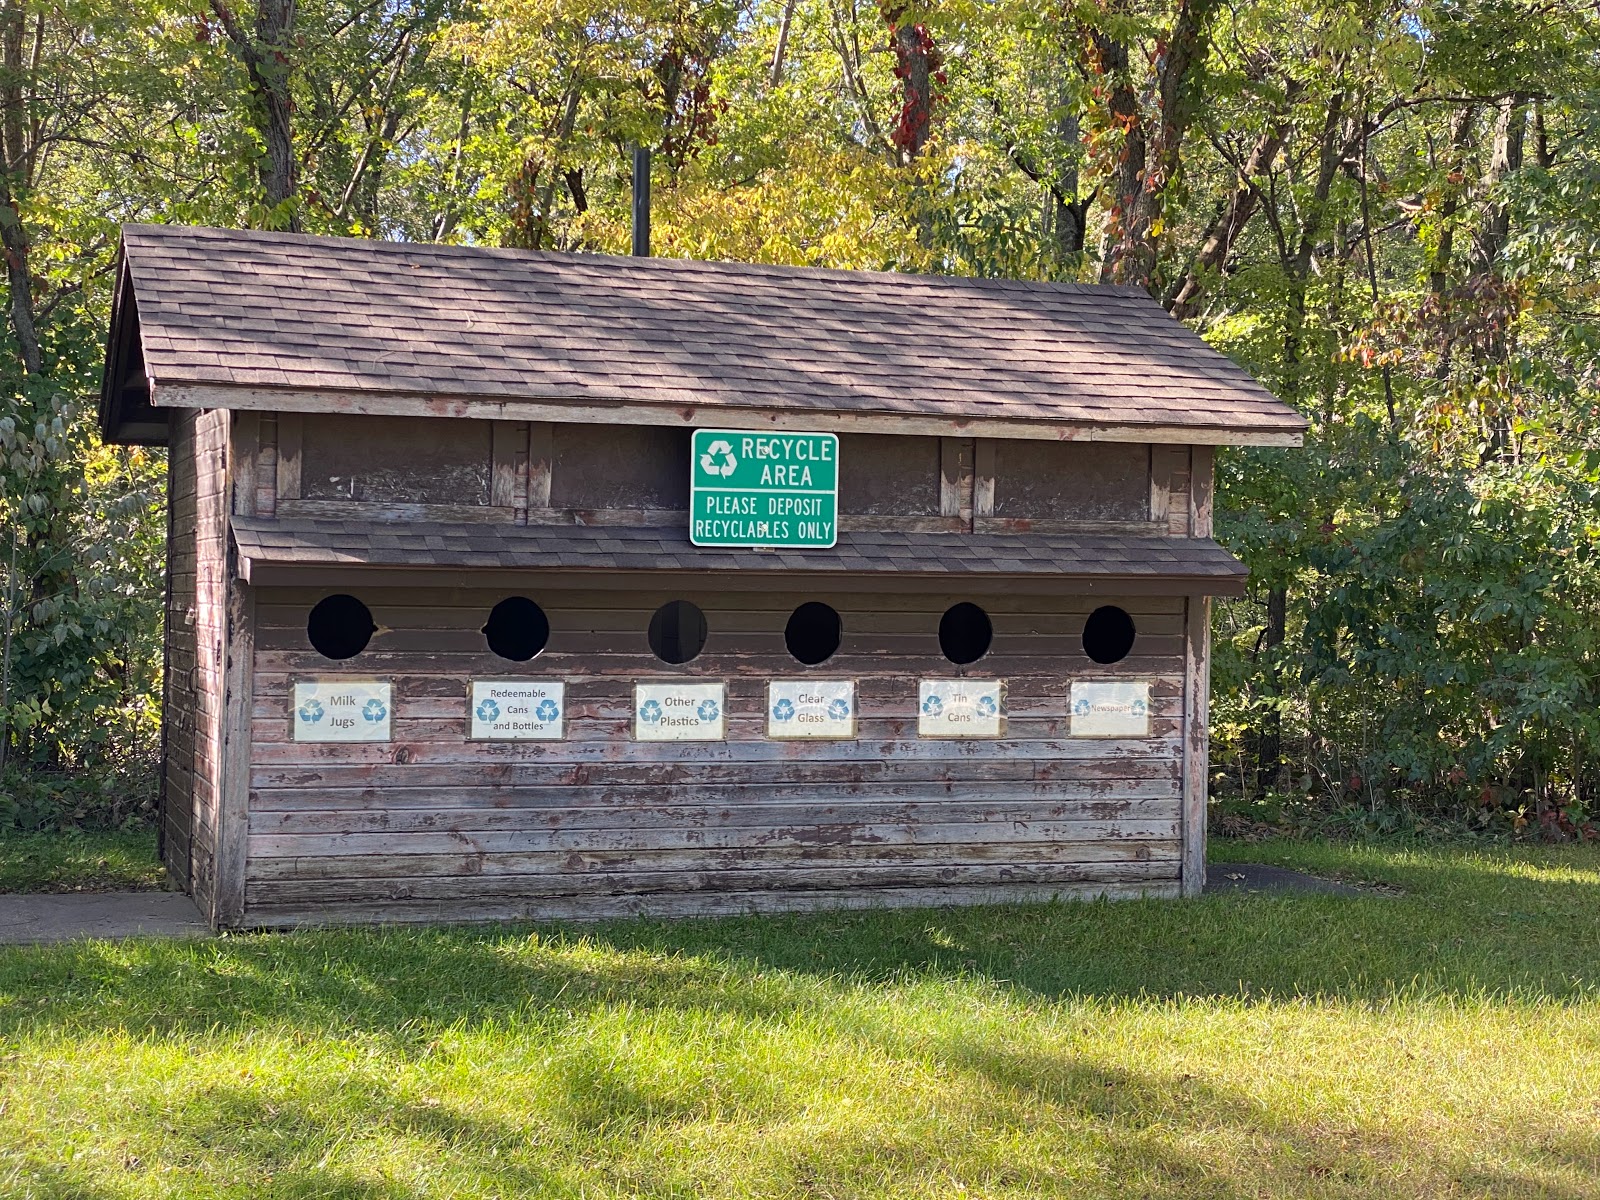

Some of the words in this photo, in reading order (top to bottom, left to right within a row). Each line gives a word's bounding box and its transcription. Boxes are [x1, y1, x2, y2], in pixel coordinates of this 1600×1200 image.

[742, 437, 832, 461] RECYCLE
[760, 464, 813, 487] AREA
[706, 496, 758, 515] PLEASE
[768, 498, 823, 516] DEPOSIT
[695, 520, 789, 539] RECYCLABLES
[798, 522, 832, 540] ONLY
[490, 689, 546, 698] Redeemable
[798, 693, 825, 704] Clear
[952, 693, 968, 703] Tin
[330, 695, 356, 706] Milk
[664, 697, 696, 707] Other
[507, 705, 529, 714] Cans
[1091, 704, 1131, 713] Newspaper
[660, 716, 699, 727] Plastics
[797, 712, 825, 723] Glass
[947, 712, 971, 722] Cans
[329, 717, 355, 729] Jugs
[493, 722, 510, 730] and
[512, 721, 544, 730] Bottles
